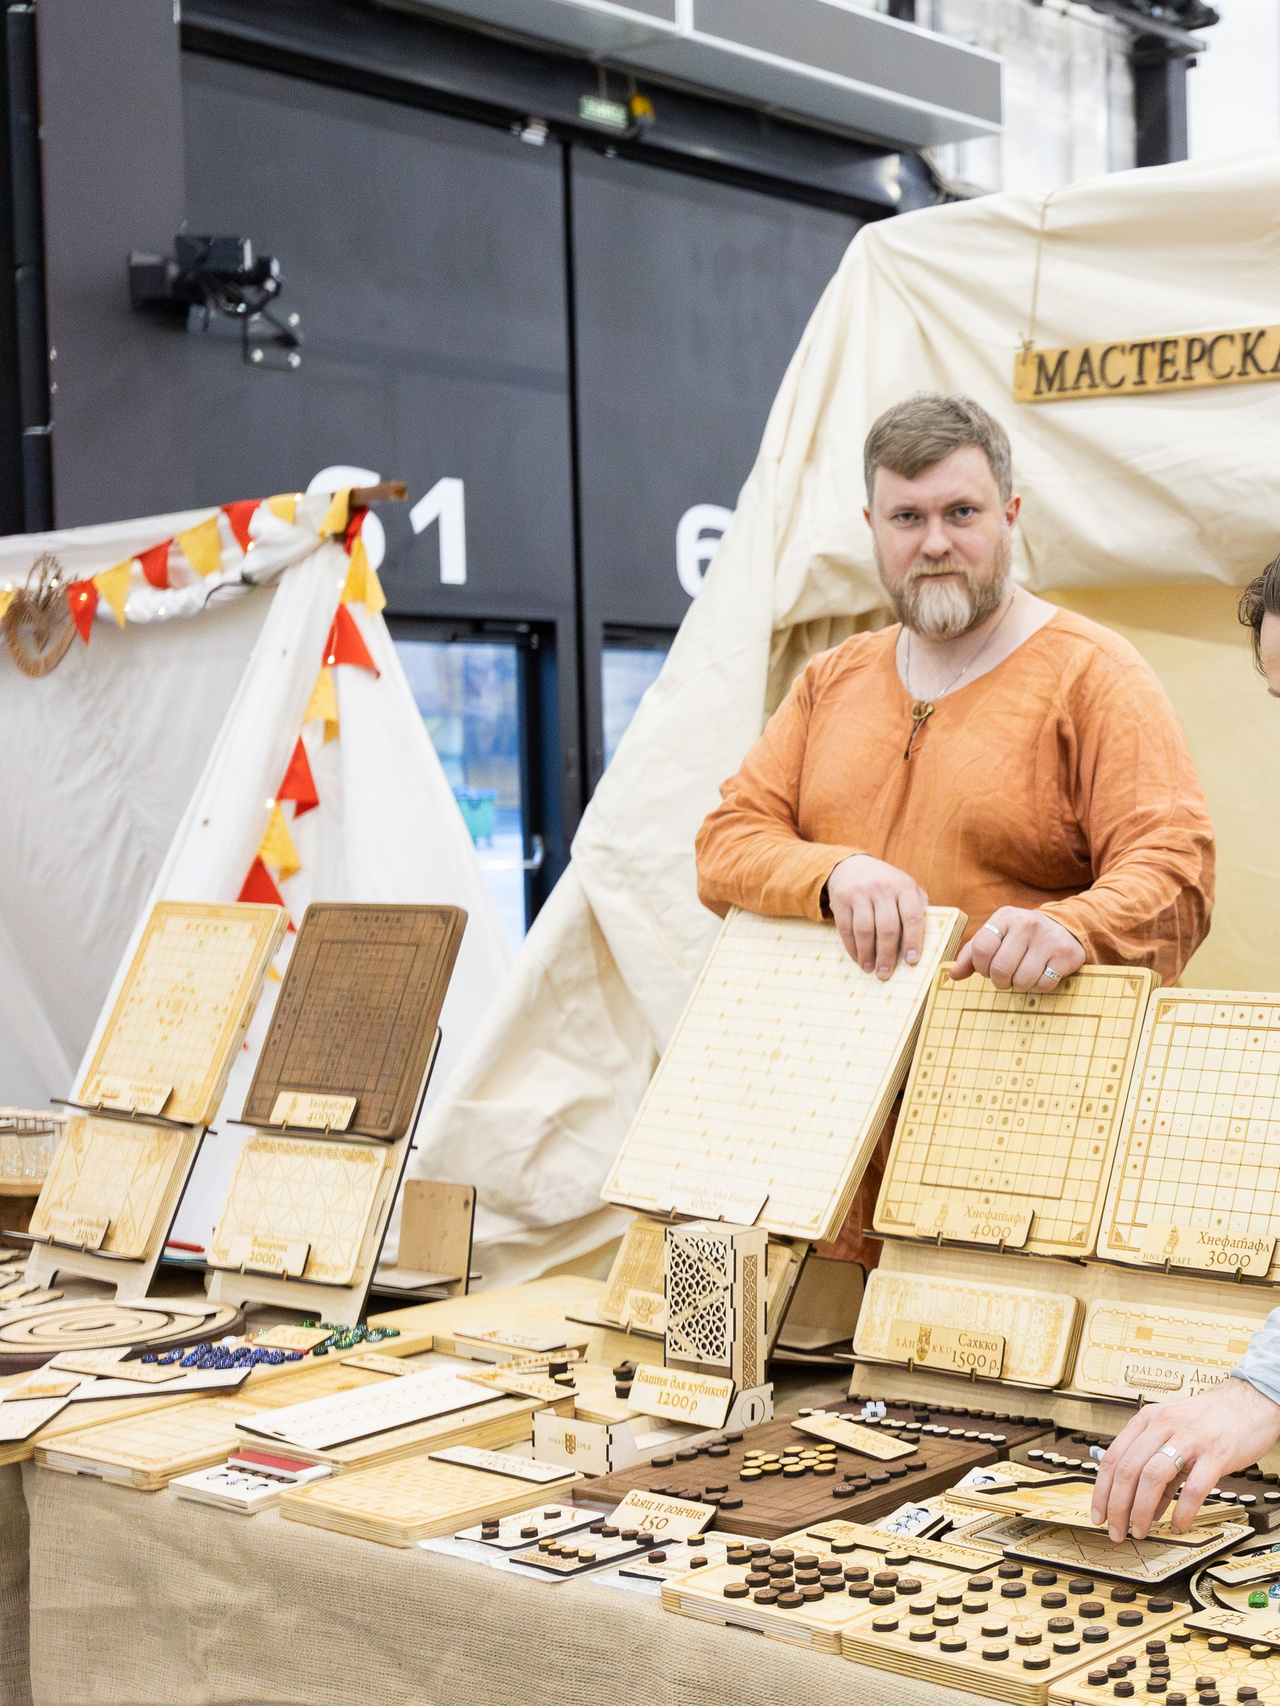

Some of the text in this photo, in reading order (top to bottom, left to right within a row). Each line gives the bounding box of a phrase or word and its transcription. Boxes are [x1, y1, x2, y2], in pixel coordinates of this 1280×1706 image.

[964, 1205, 1027, 1227] Хнефатафл
[970, 1224, 1012, 1239] 4000
[1197, 1231, 1270, 1255] Хнефатафл
[1142, 1252, 1192, 1266] HNEFTAFL
[1205, 1250, 1251, 1267] 3000
[958, 1332, 998, 1352] Сахкко
[952, 1350, 987, 1368] 1500
[637, 1369, 729, 1398] Башня для кубиков
[656, 1391, 689, 1409] 1200
[625, 1493, 706, 1520] Заяц и гончие
[638, 1515, 669, 1531] 150
